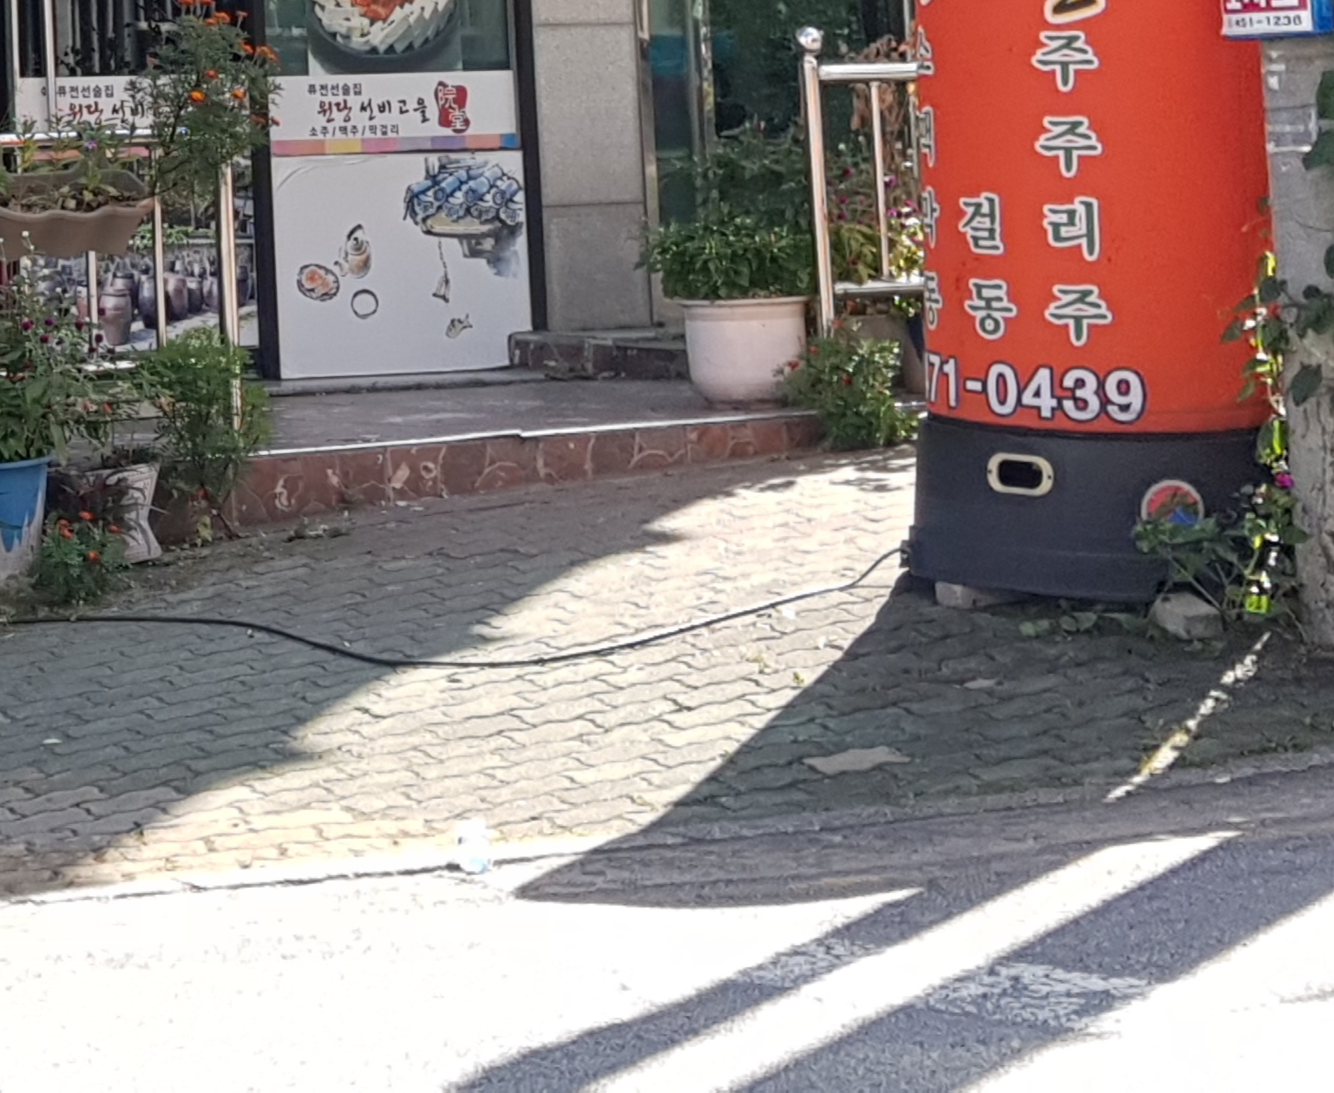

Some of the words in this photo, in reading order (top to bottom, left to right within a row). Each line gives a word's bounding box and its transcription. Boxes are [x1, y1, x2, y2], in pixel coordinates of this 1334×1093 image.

[57, 84, 115, 99] 퓨전선술집
[307, 83, 363, 97] 퓨전선술집
[317, 100, 352, 124] 원당
[359, 97, 430, 123] 선비고을
[927, 353, 1146, 424] 71-0439
